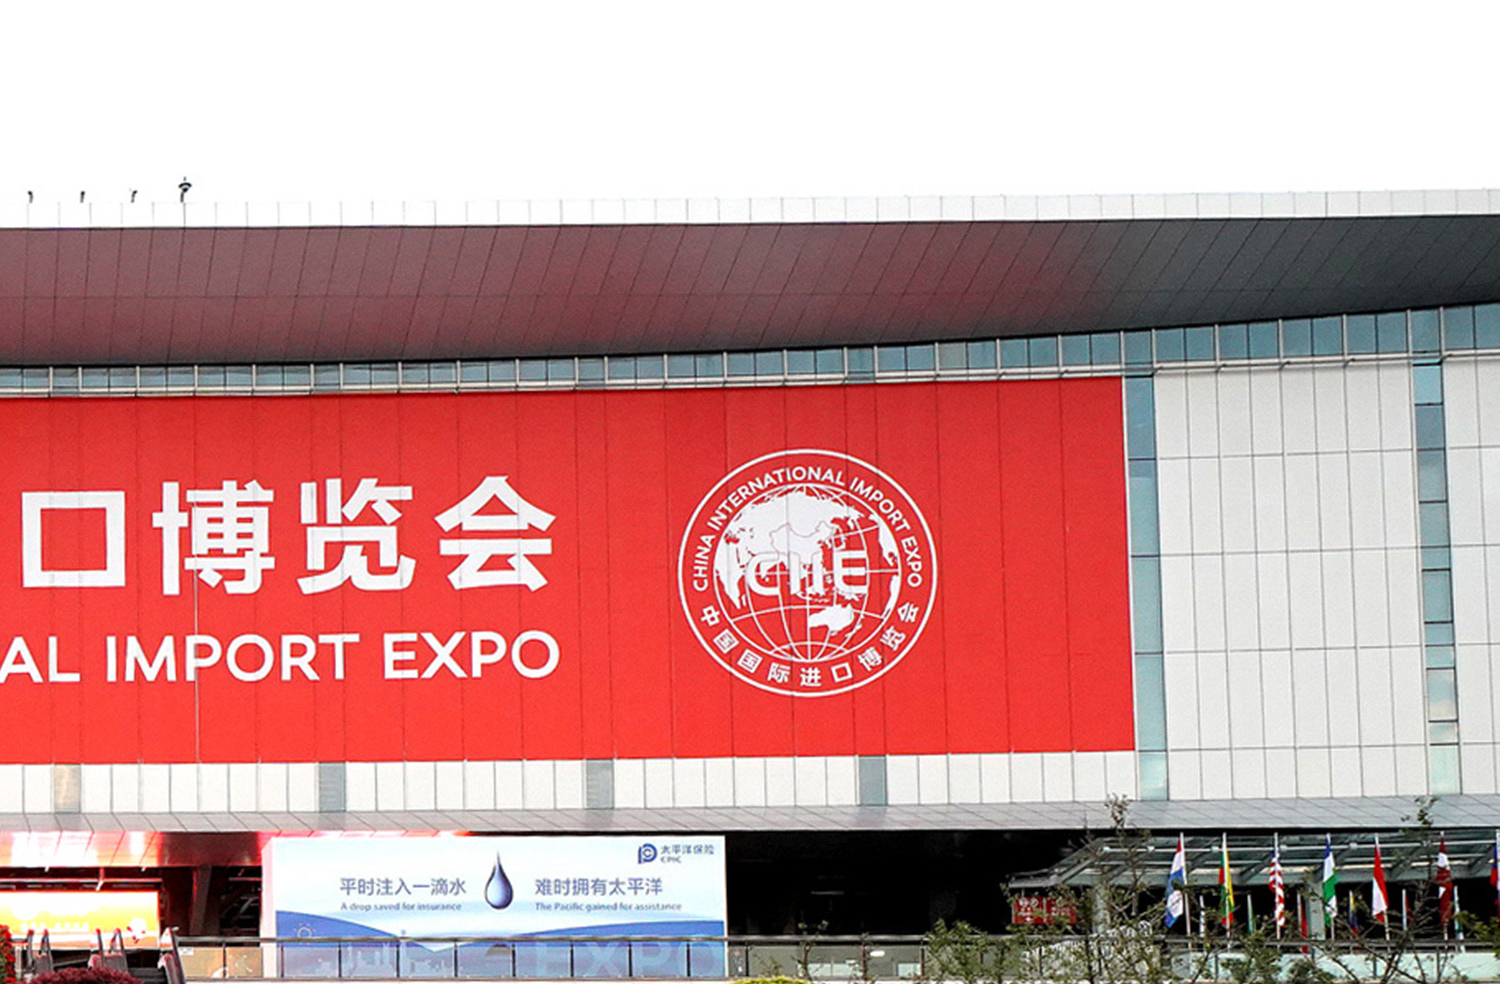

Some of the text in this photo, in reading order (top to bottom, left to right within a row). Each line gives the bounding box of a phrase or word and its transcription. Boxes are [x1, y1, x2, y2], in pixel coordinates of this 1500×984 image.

[693, 466, 922, 591] CHINA INTERNATIONAL IMPORT EXPO
[746, 550, 869, 596] CIIE
[106, 633, 360, 682] IMPORT
[383, 630, 560, 679] EXPO
[700, 602, 919, 686] 中国国际进口博览会
[340, 877, 466, 896] 平时注入一滴水
[535, 877, 663, 896] 难时拥有太平洋
[340, 902, 462, 913] A drop saved for insurance
[535, 902, 682, 913] The Pacific gained for assistance
